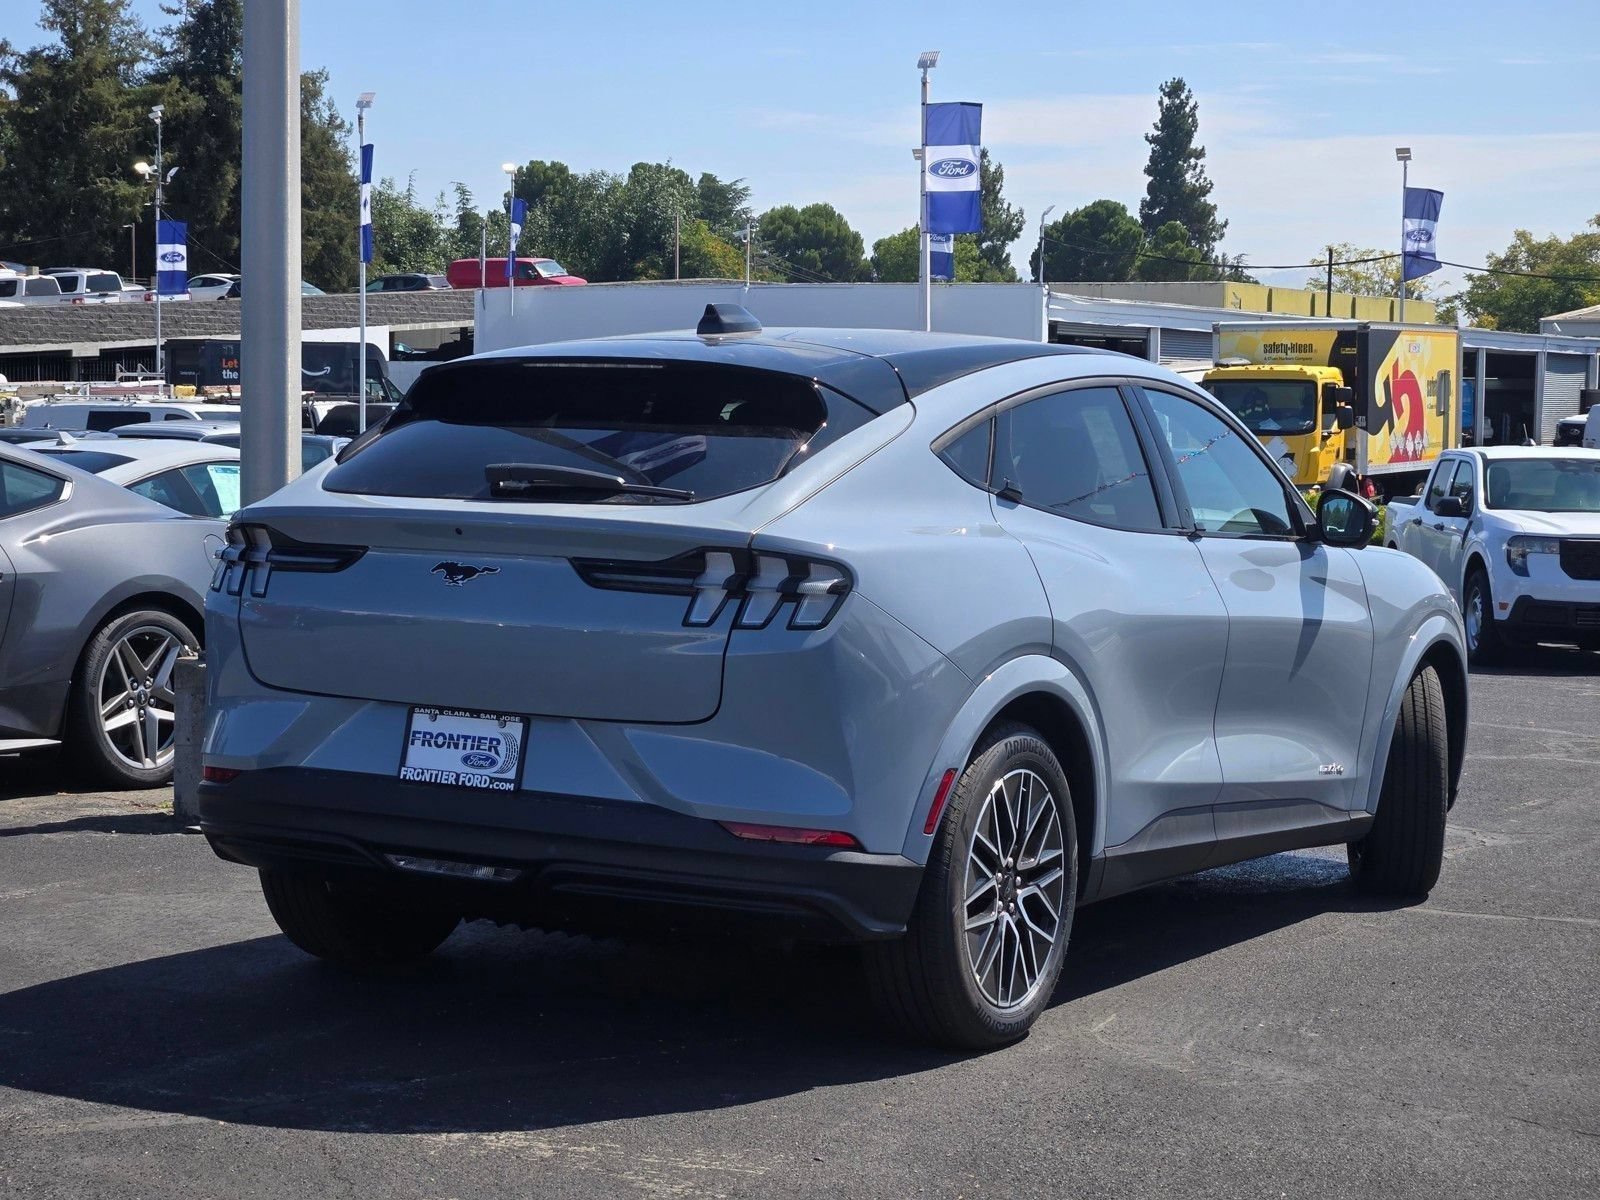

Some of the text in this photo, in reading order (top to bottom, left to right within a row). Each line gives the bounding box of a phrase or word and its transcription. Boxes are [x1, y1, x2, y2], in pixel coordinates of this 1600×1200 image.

[938, 161, 969, 175] Ford
[1411, 230, 1430, 241] Ford
[165, 252, 183, 262] Ford
[222, 358, 238, 368] Let
[222, 369, 239, 379] the
[414, 707, 440, 715] SANTA
[443, 709, 471, 717] CLARA
[480, 712, 497, 720] SAN
[410, 730, 501, 758] FRONTIER
[467, 755, 491, 767] Ford
[1004, 737, 1061, 779] BRIDGESTONE
[400, 766, 457, 785] FRONTIER
